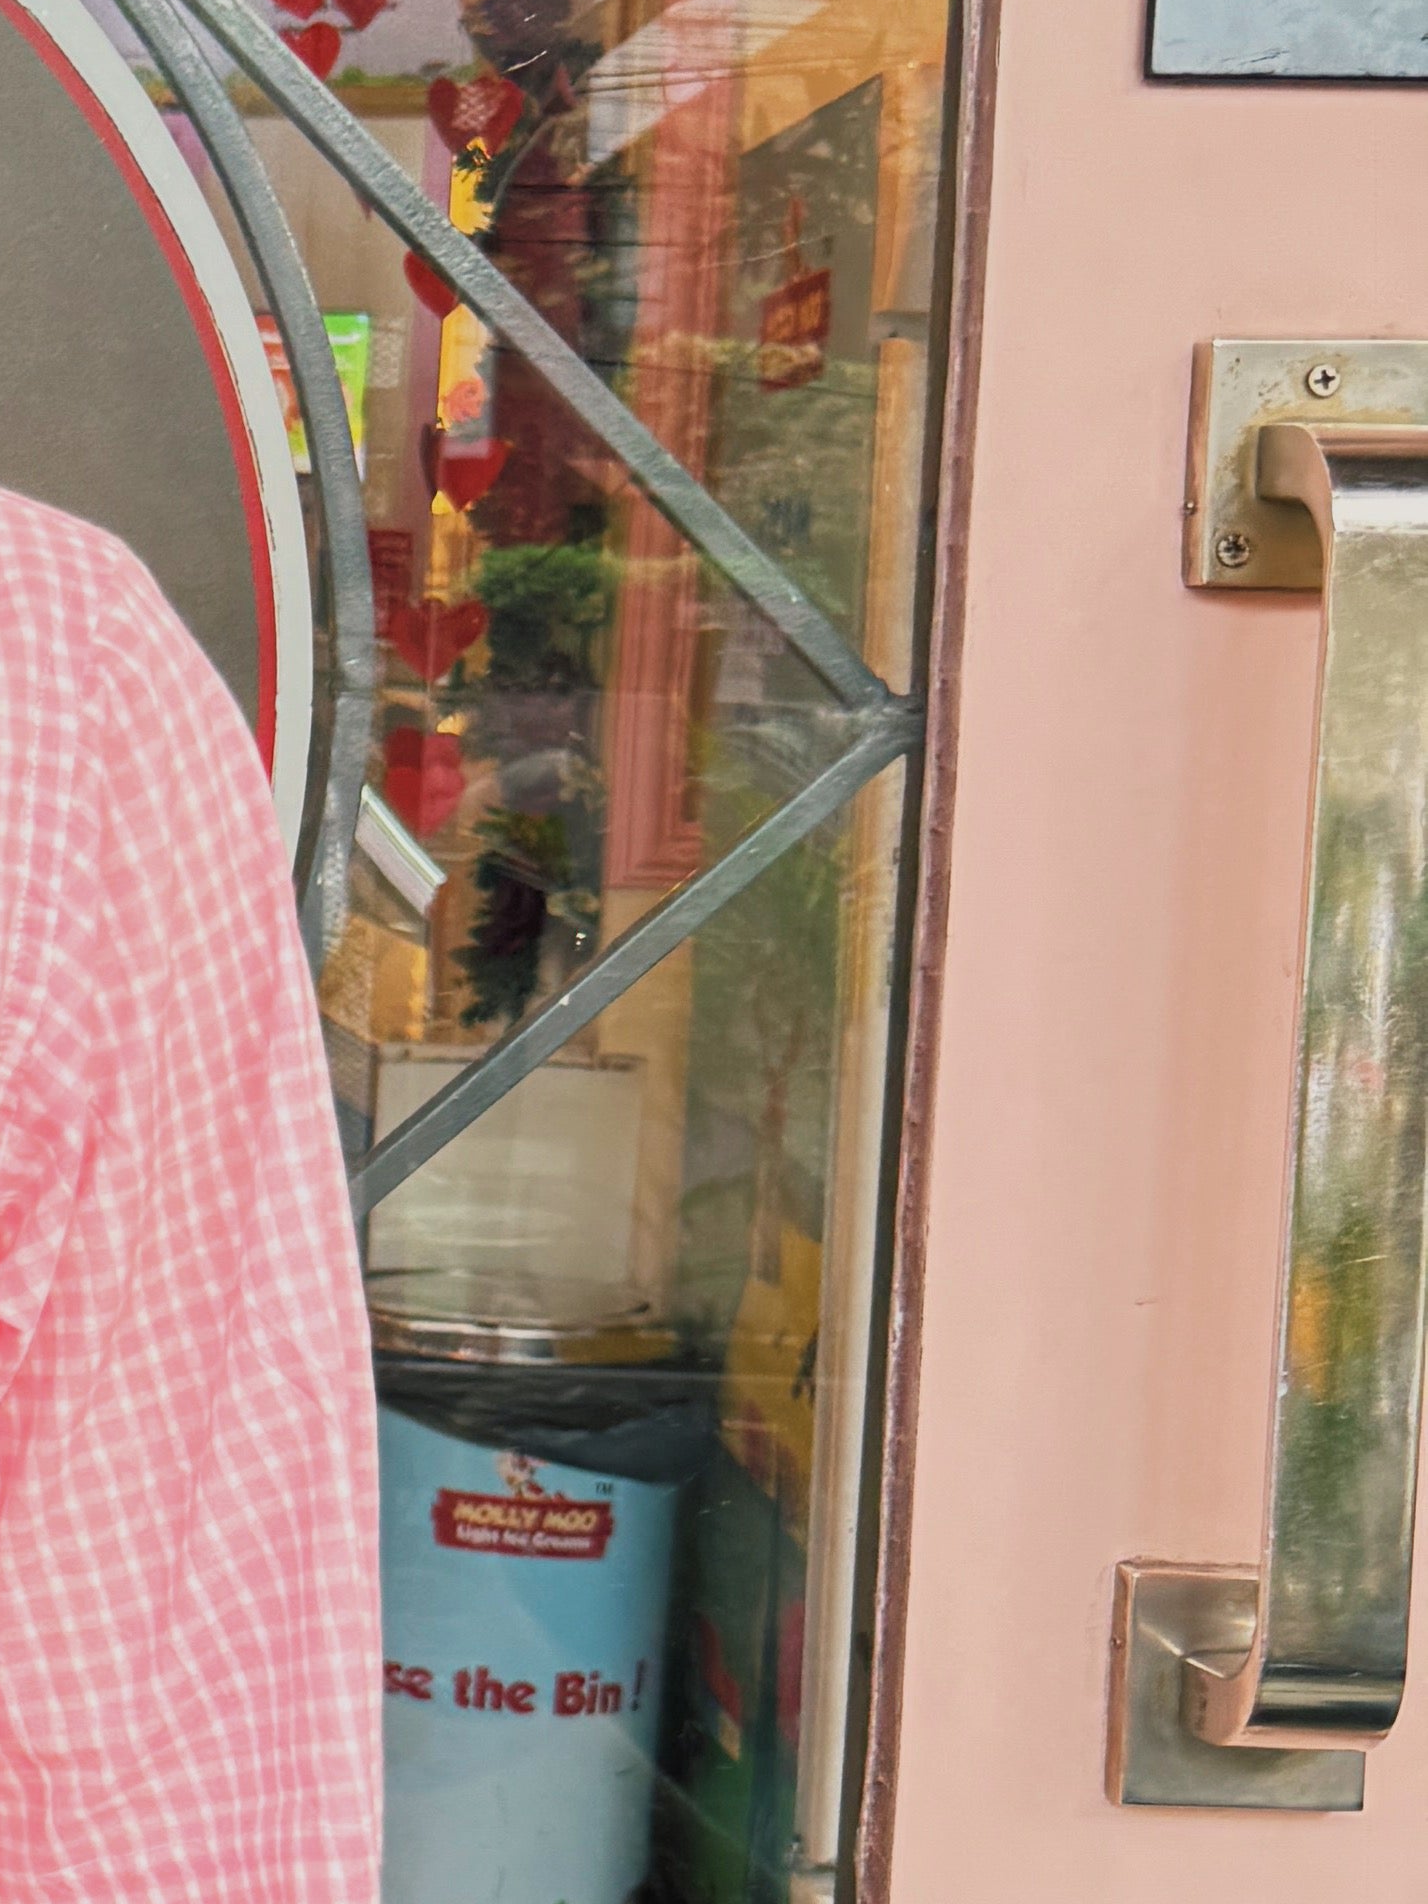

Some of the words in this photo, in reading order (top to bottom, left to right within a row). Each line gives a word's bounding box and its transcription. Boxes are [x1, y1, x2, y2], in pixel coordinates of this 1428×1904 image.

[453, 1500, 540, 1529] MOLLY
[543, 1509, 599, 1533] MOO
[383, 1658, 434, 1701] se
[452, 1664, 536, 1714] the
